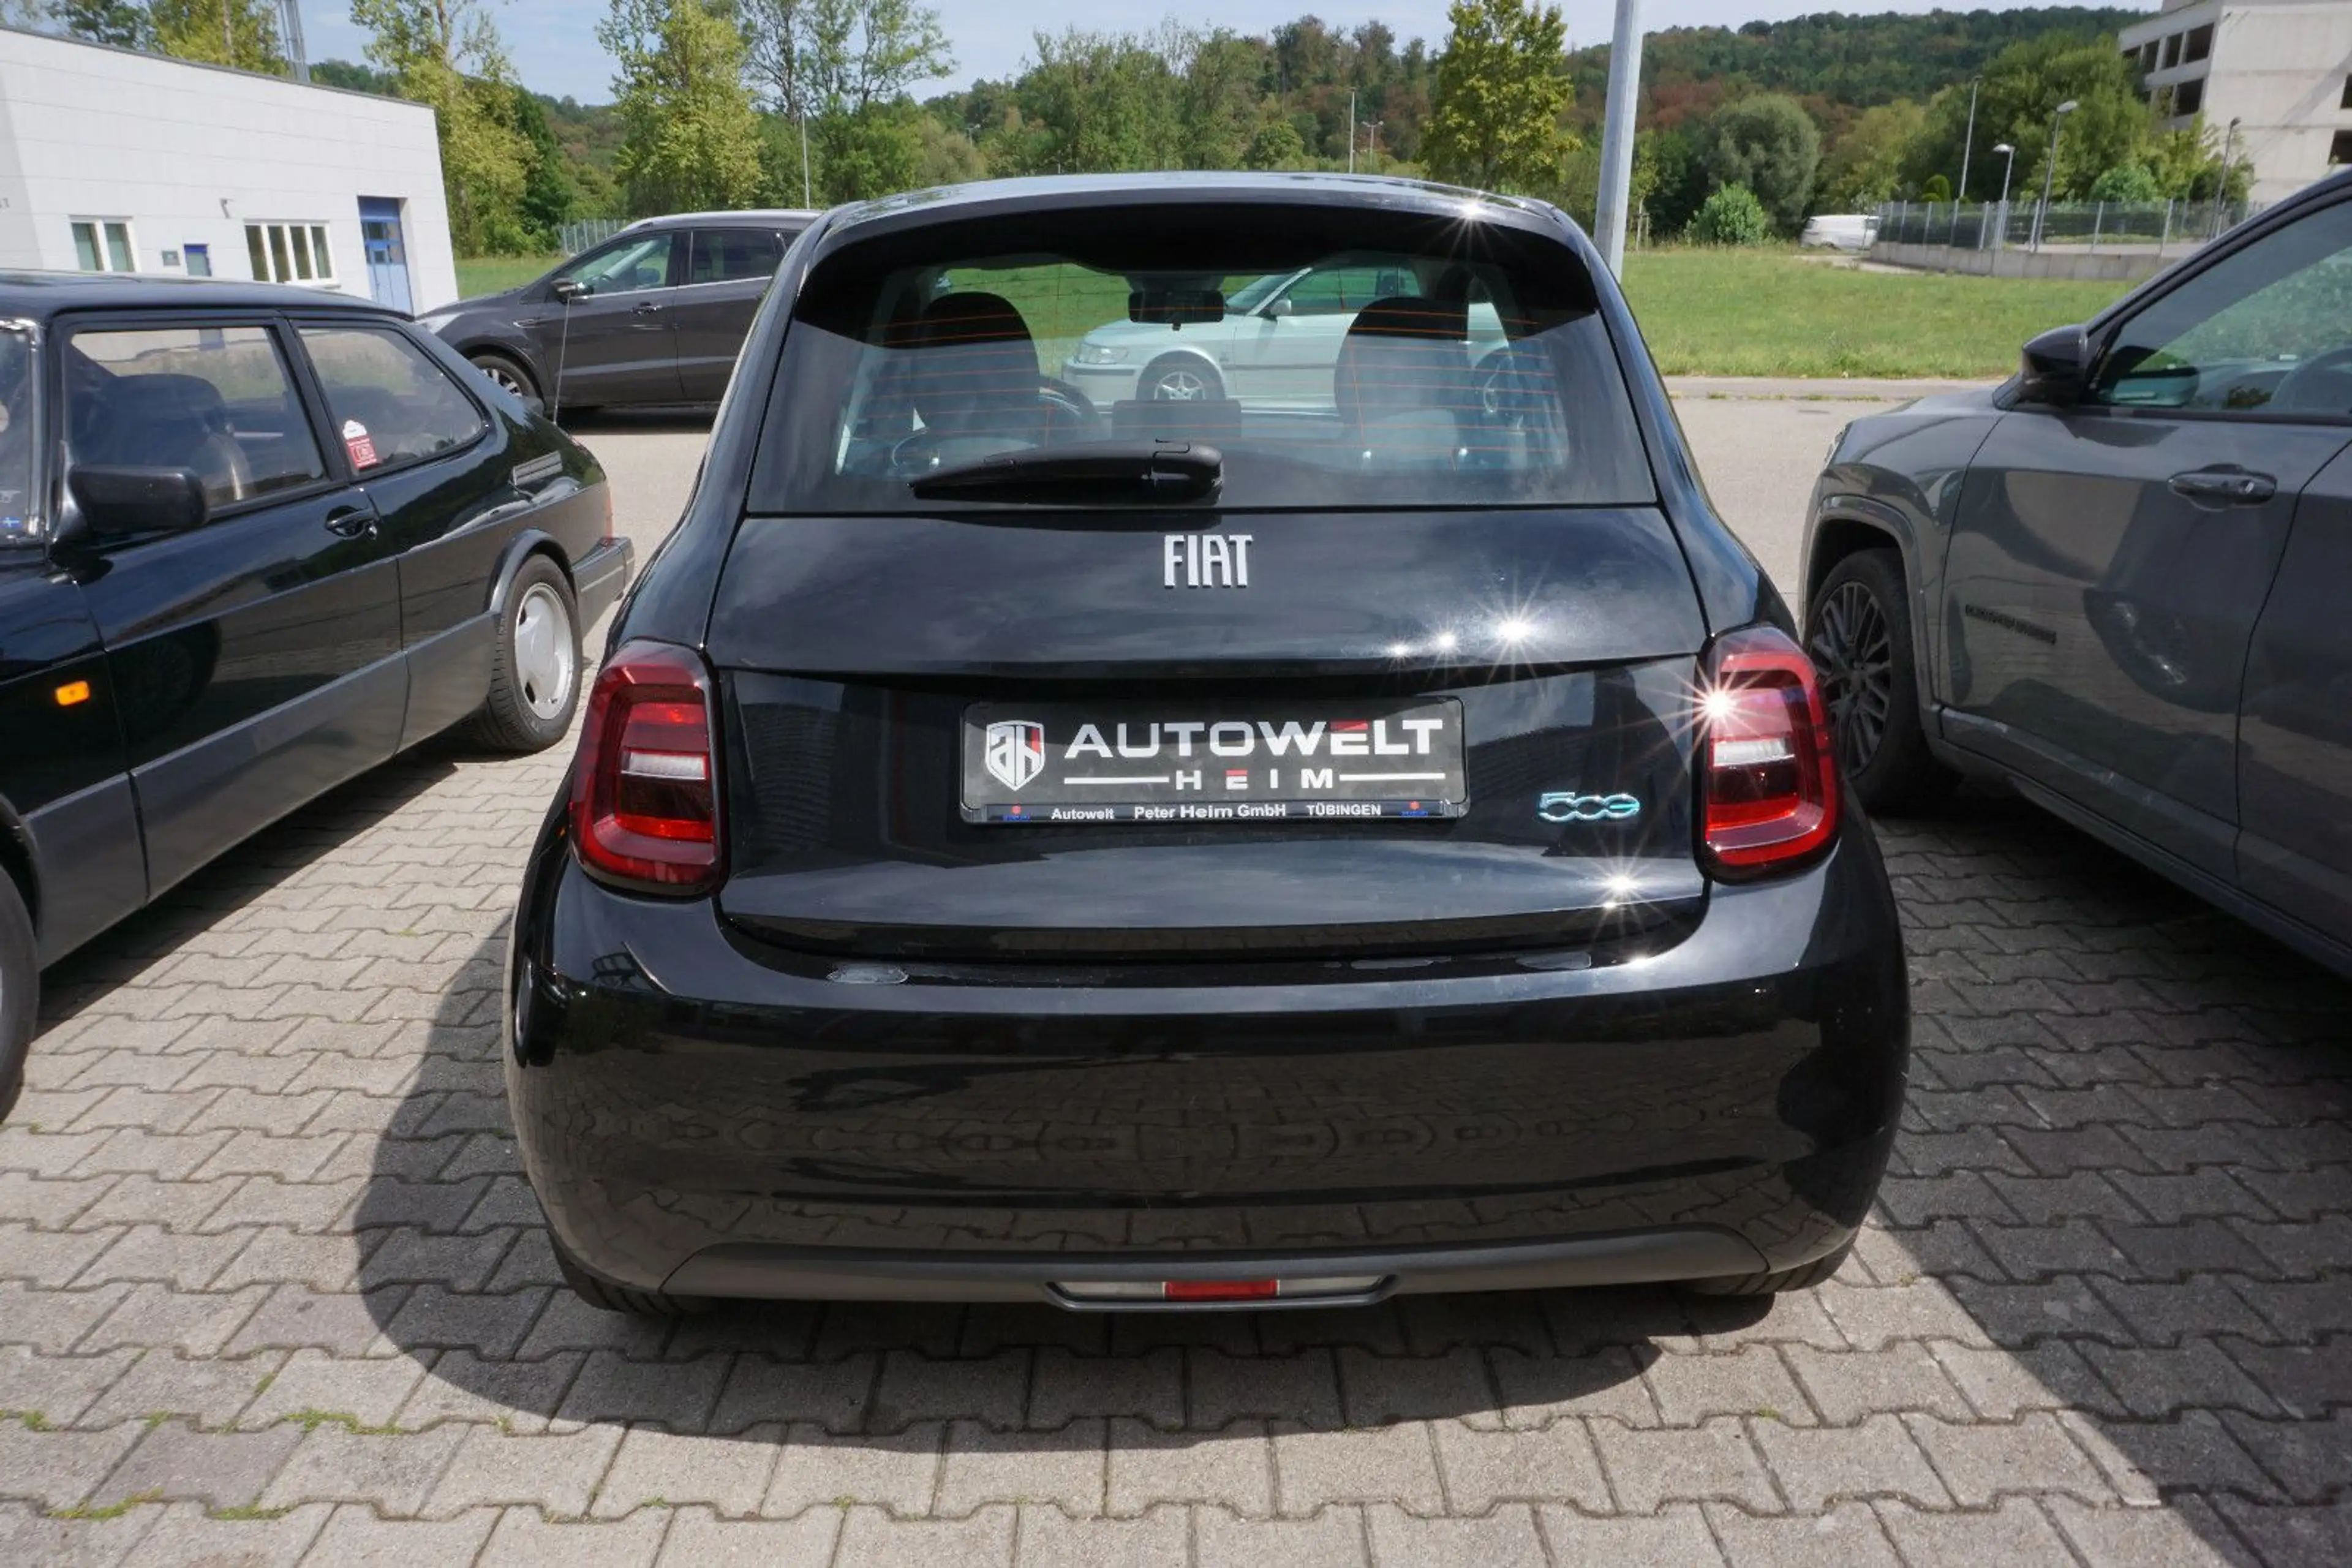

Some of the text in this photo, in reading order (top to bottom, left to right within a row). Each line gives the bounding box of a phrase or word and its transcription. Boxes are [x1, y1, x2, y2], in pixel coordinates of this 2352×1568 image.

[1164, 534, 1253, 586] FIAT
[1065, 719, 1443, 758] AUTOWELT
[1175, 768, 1333, 790] HEIM
[1051, 802, 1382, 820] Autowelt Peter Heim GmbH TÜBINGEN
